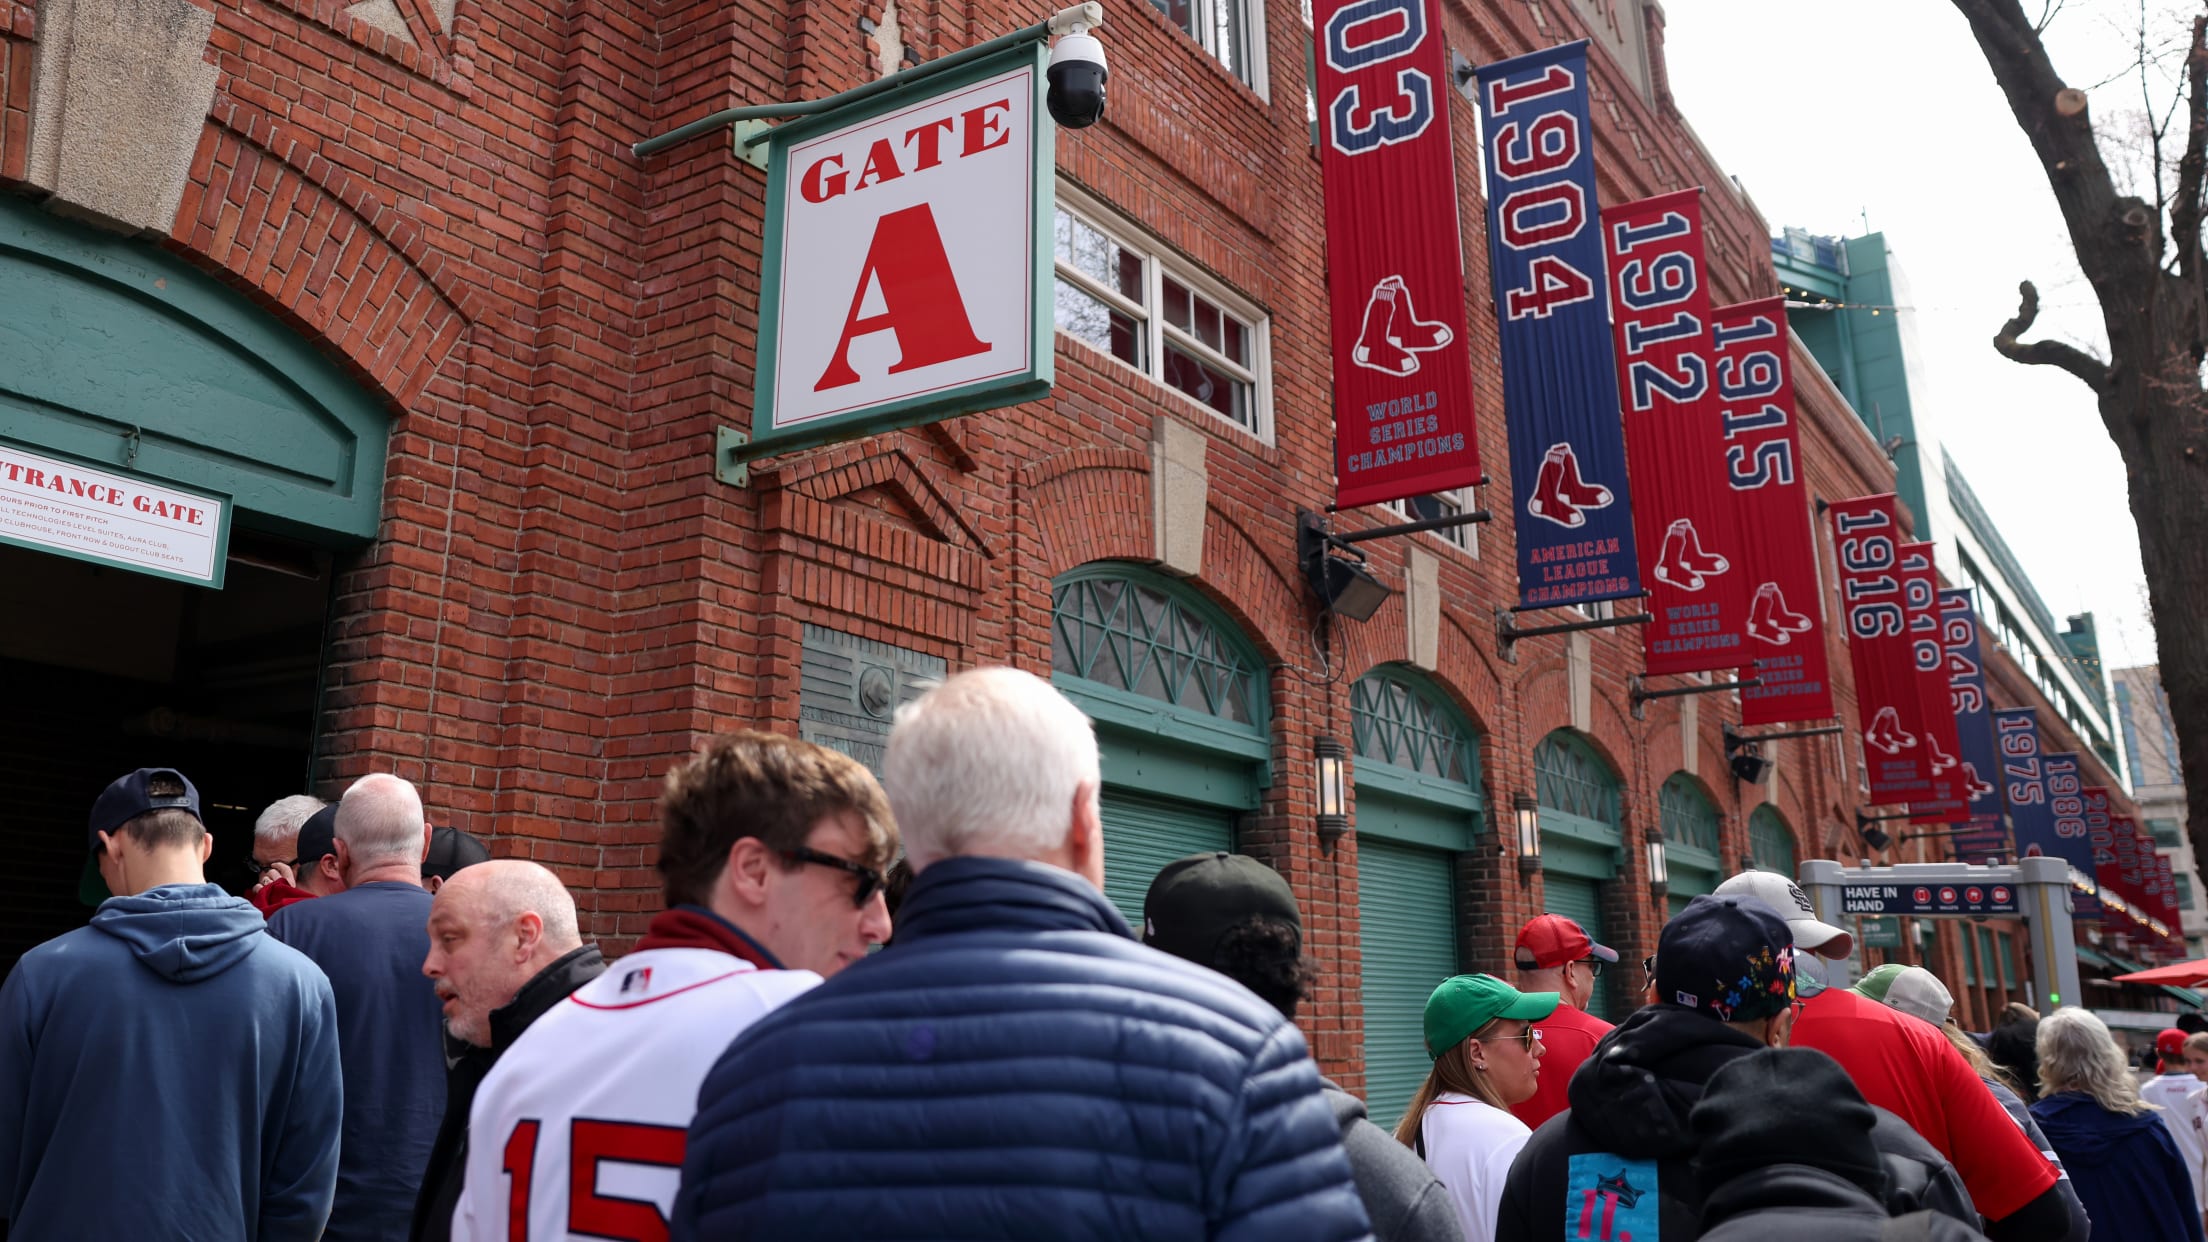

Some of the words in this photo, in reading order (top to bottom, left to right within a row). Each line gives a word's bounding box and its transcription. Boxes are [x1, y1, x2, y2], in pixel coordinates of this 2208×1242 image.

[800, 98, 1011, 204] GATE
[1489, 65, 1595, 321] 1904
[813, 202, 993, 393] A
[1614, 211, 1709, 411] 1912
[1366, 391, 1438, 421] WORLD
[1711, 316, 1794, 490] 1915
[1369, 414, 1438, 444] SERIES
[1348, 433, 1464, 472] CHAMPIONS
[12, 509, 72, 527] TECHNOLOGIES
[73, 523, 97, 533] LEVEL
[98, 529, 126, 541] SUITES,
[127, 536, 147, 545] AURA
[24, 501, 49, 511] PRIOR
[62, 510, 86, 519] FIRST
[86, 515, 109, 525] PITCH
[133, 495, 204, 526] GATE
[4, 518, 55, 535] CLUBHOUSE,
[56, 530, 81, 543] FRONT
[83, 536, 101, 546] ROW
[109, 541, 139, 554] DUGOUT
[140, 548, 160, 558] CLUB
[161, 553, 184, 563] SEATS
[1530, 537, 1620, 563] AMERICAN
[1543, 559, 1609, 582] LEAGUE
[1837, 509, 1905, 638] 1916
[1528, 576, 1630, 603] CHAMPIONS
[1666, 602, 1720, 620] WORLD
[1669, 619, 1720, 636] SERIES
[1653, 633, 1740, 654] CHAMPIONS
[1939, 595, 1983, 714] 1946
[1759, 655, 1804, 670] WORLD
[1745, 681, 1821, 699] CHAMPIONS
[1997, 715, 2045, 806] 1975
[2045, 760, 2087, 838] 1986
[2082, 793, 2116, 865] 2004
[1846, 887, 1881, 899] HAVE
[1883, 887, 1898, 899] IN
[1847, 900, 1885, 912] HAND
[502, 1116, 689, 1242] 15
